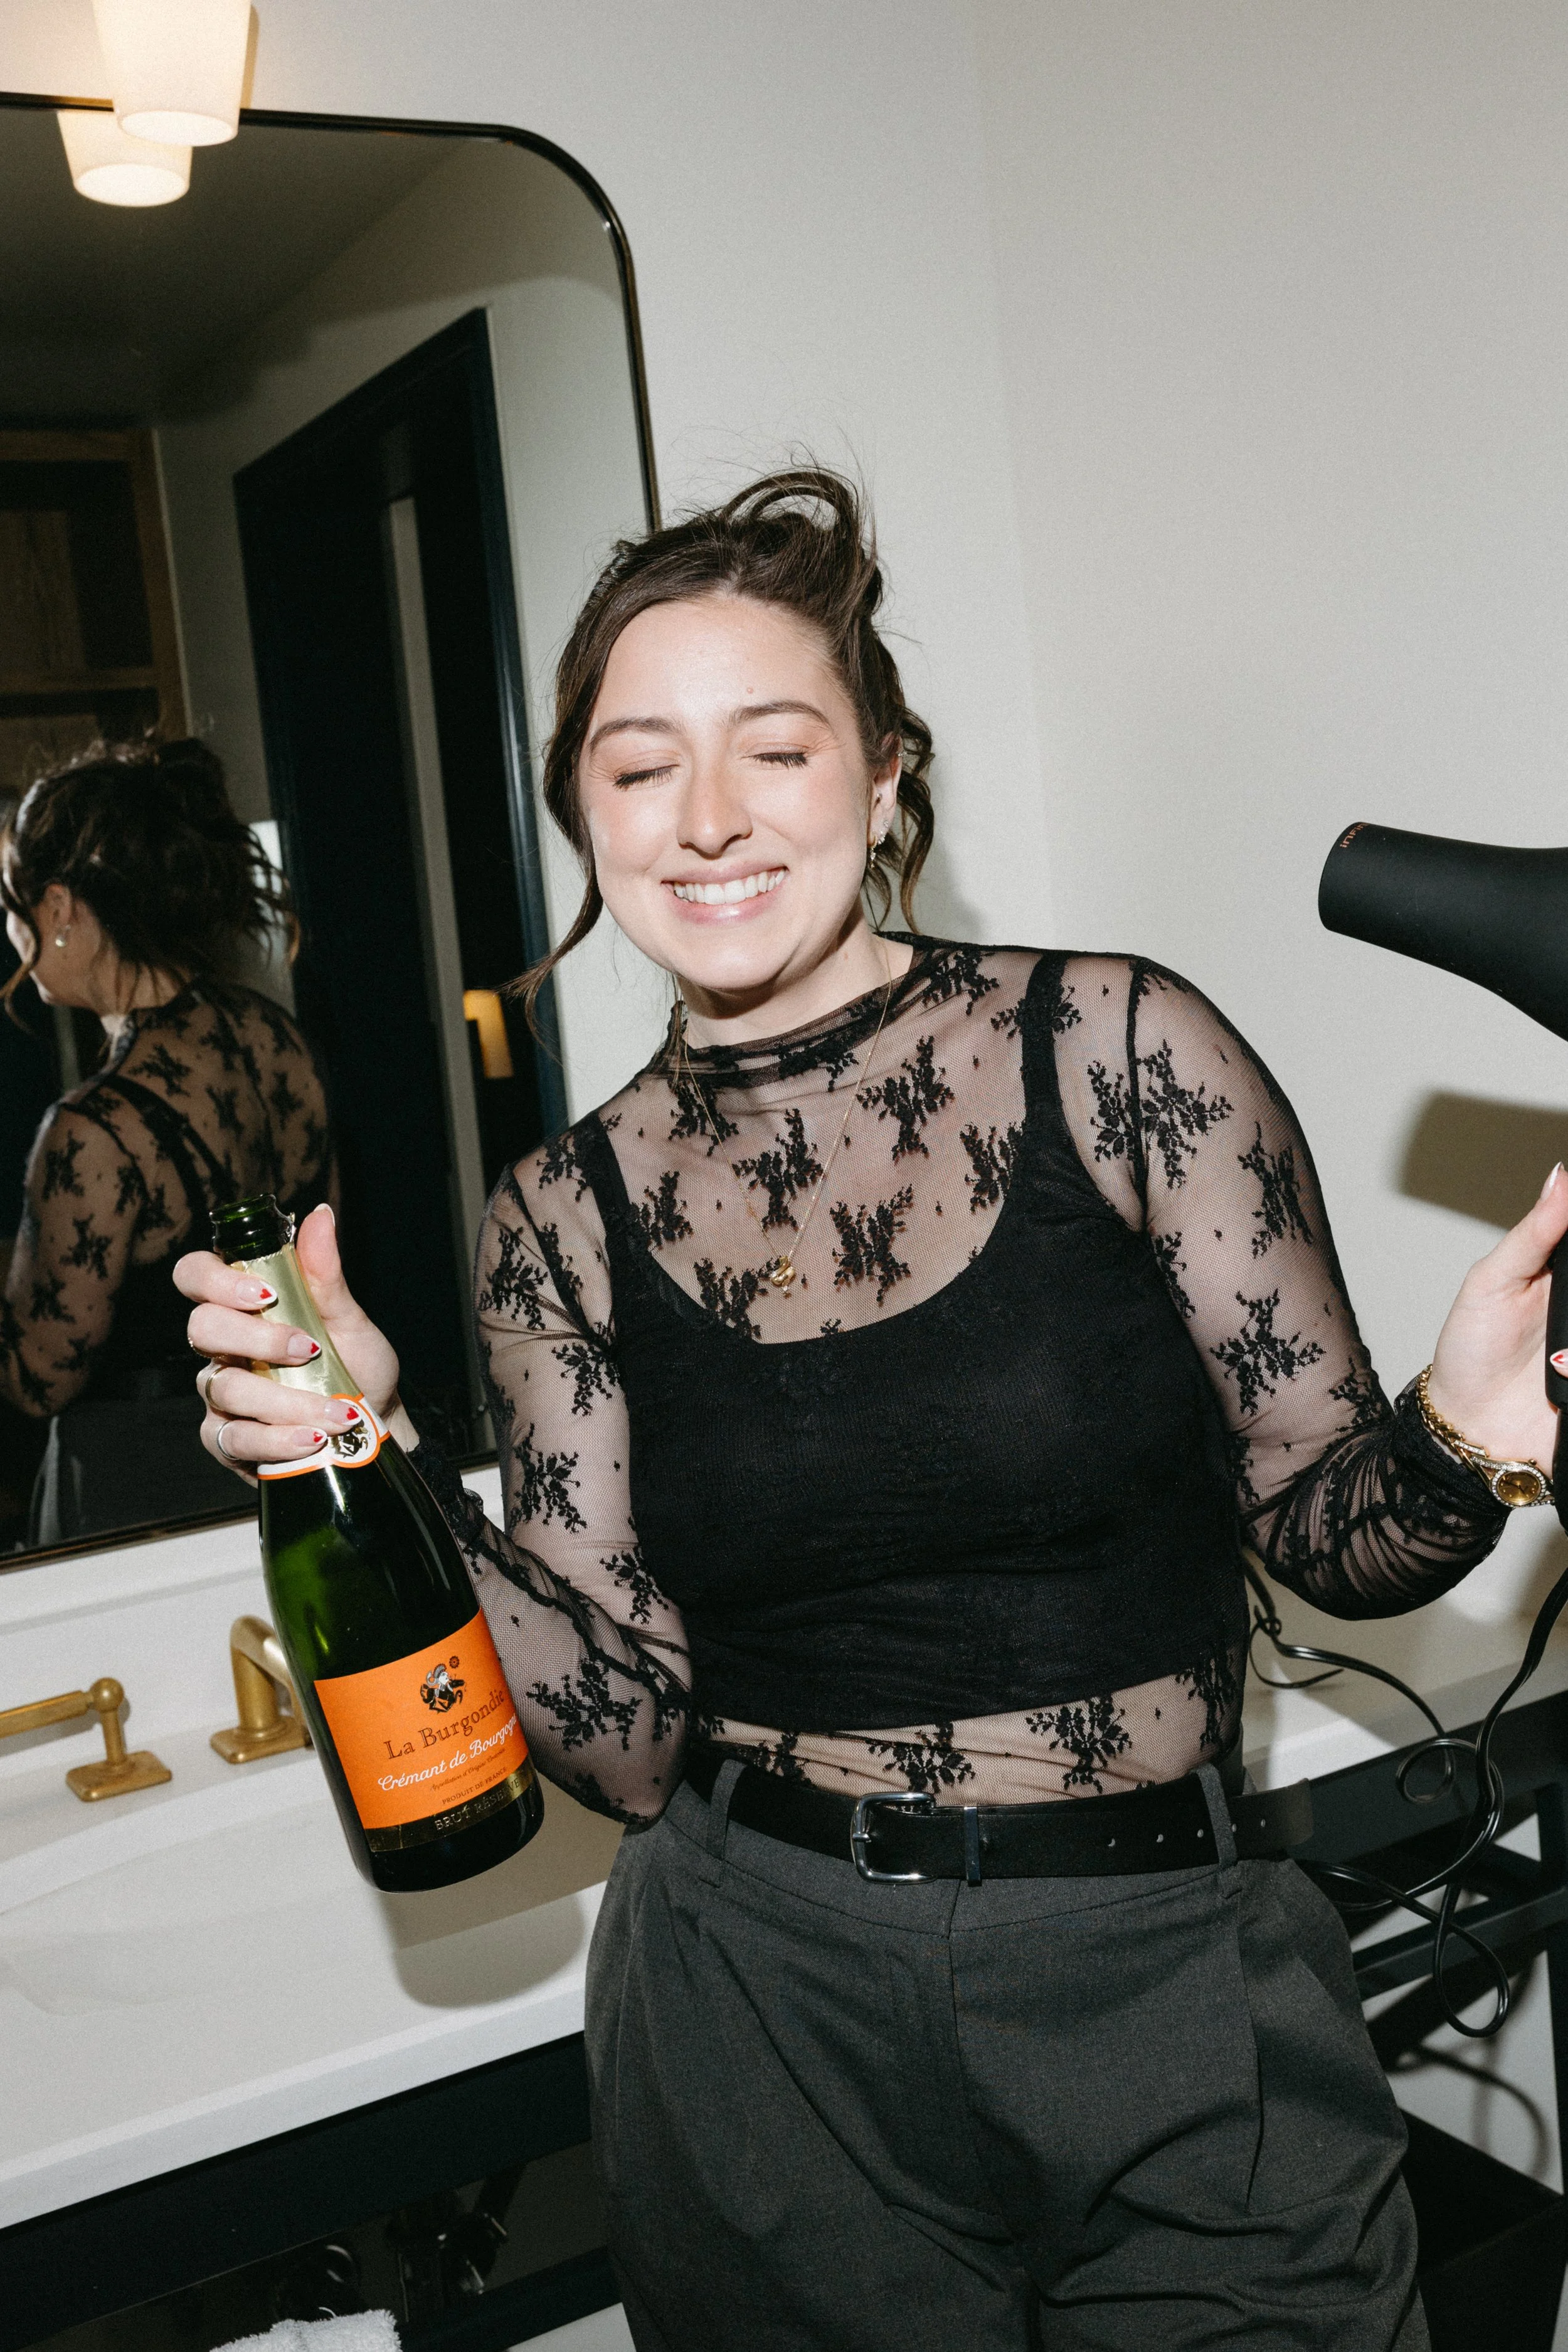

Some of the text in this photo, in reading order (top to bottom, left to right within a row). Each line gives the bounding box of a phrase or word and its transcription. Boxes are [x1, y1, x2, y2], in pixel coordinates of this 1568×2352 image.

[383, 1689, 504, 1759] La Burgondie
[378, 1760, 447, 1791] Crémant
[449, 1750, 468, 1769] de
[442, 1766, 507, 1805] PRODUIT DE FRANCE
[434, 1804, 470, 1831] BRUT
